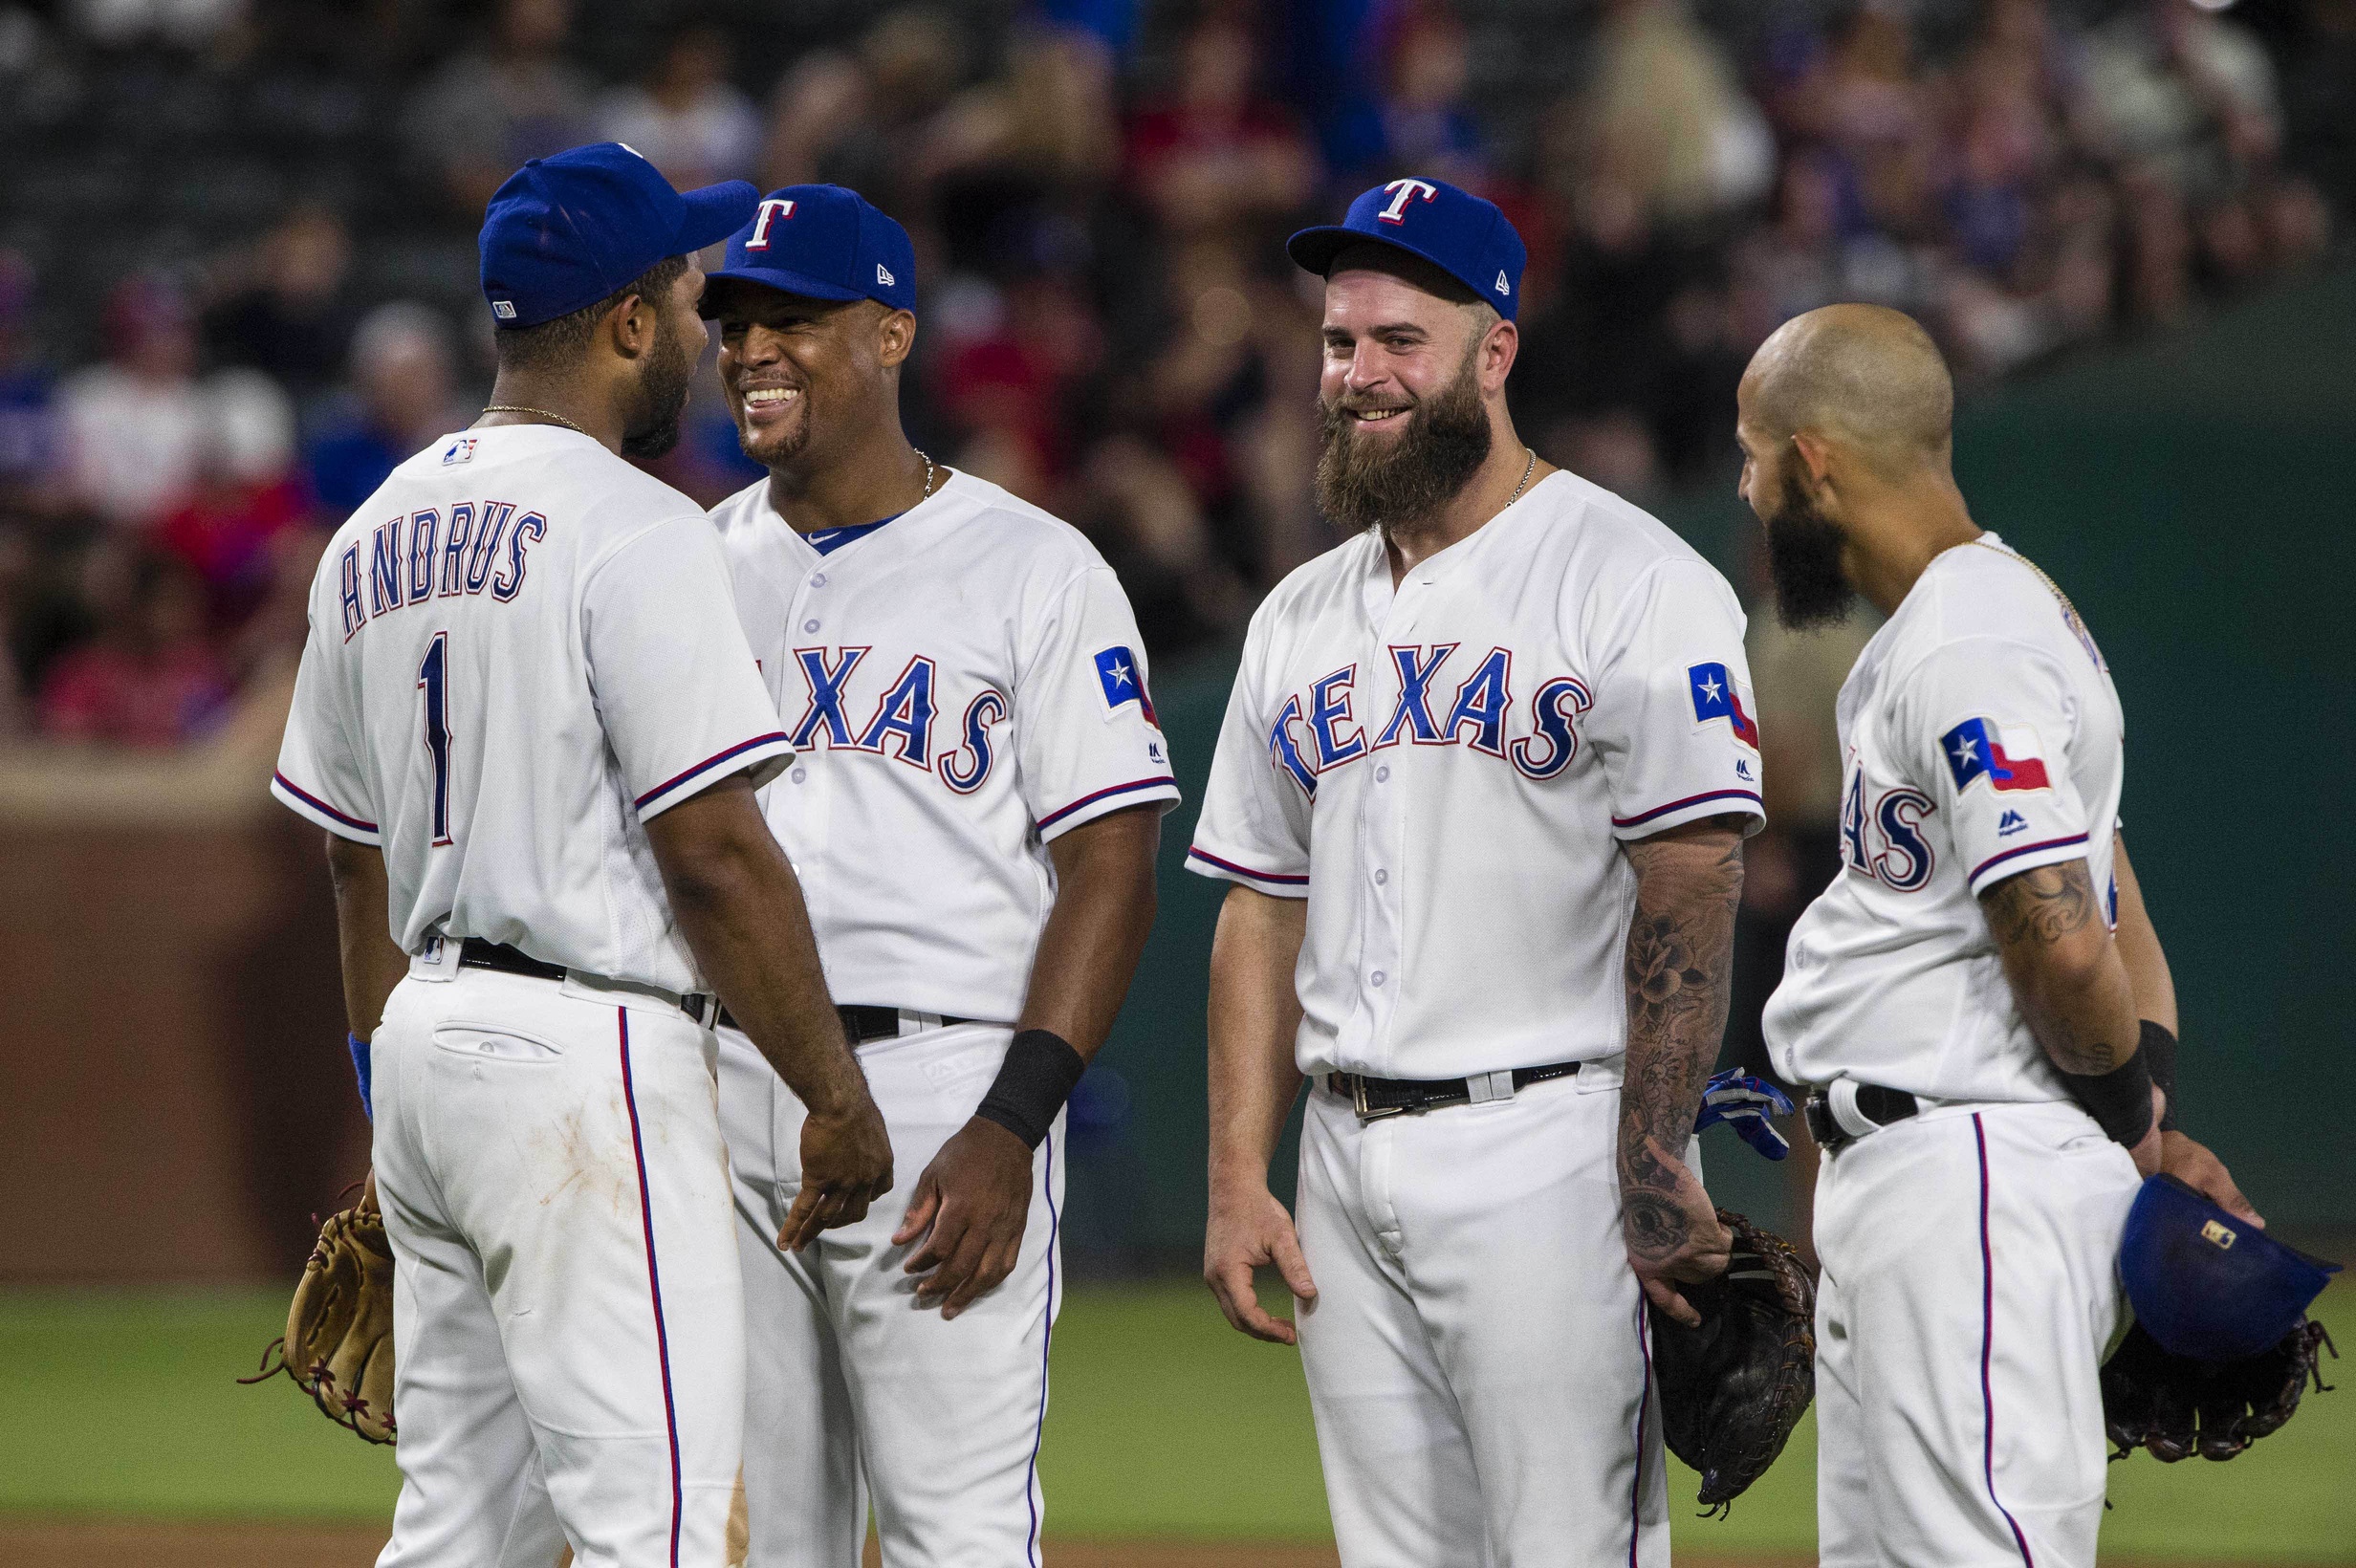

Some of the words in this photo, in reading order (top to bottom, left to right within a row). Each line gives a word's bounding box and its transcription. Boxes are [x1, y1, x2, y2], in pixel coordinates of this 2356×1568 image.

[745, 199, 797, 251] T
[1378, 178, 1439, 226] T
[339, 500, 547, 643] ANDRUS
[418, 631, 453, 847] 1
[755, 645, 1006, 795] XAS
[1269, 642, 1593, 804] TEXAS
